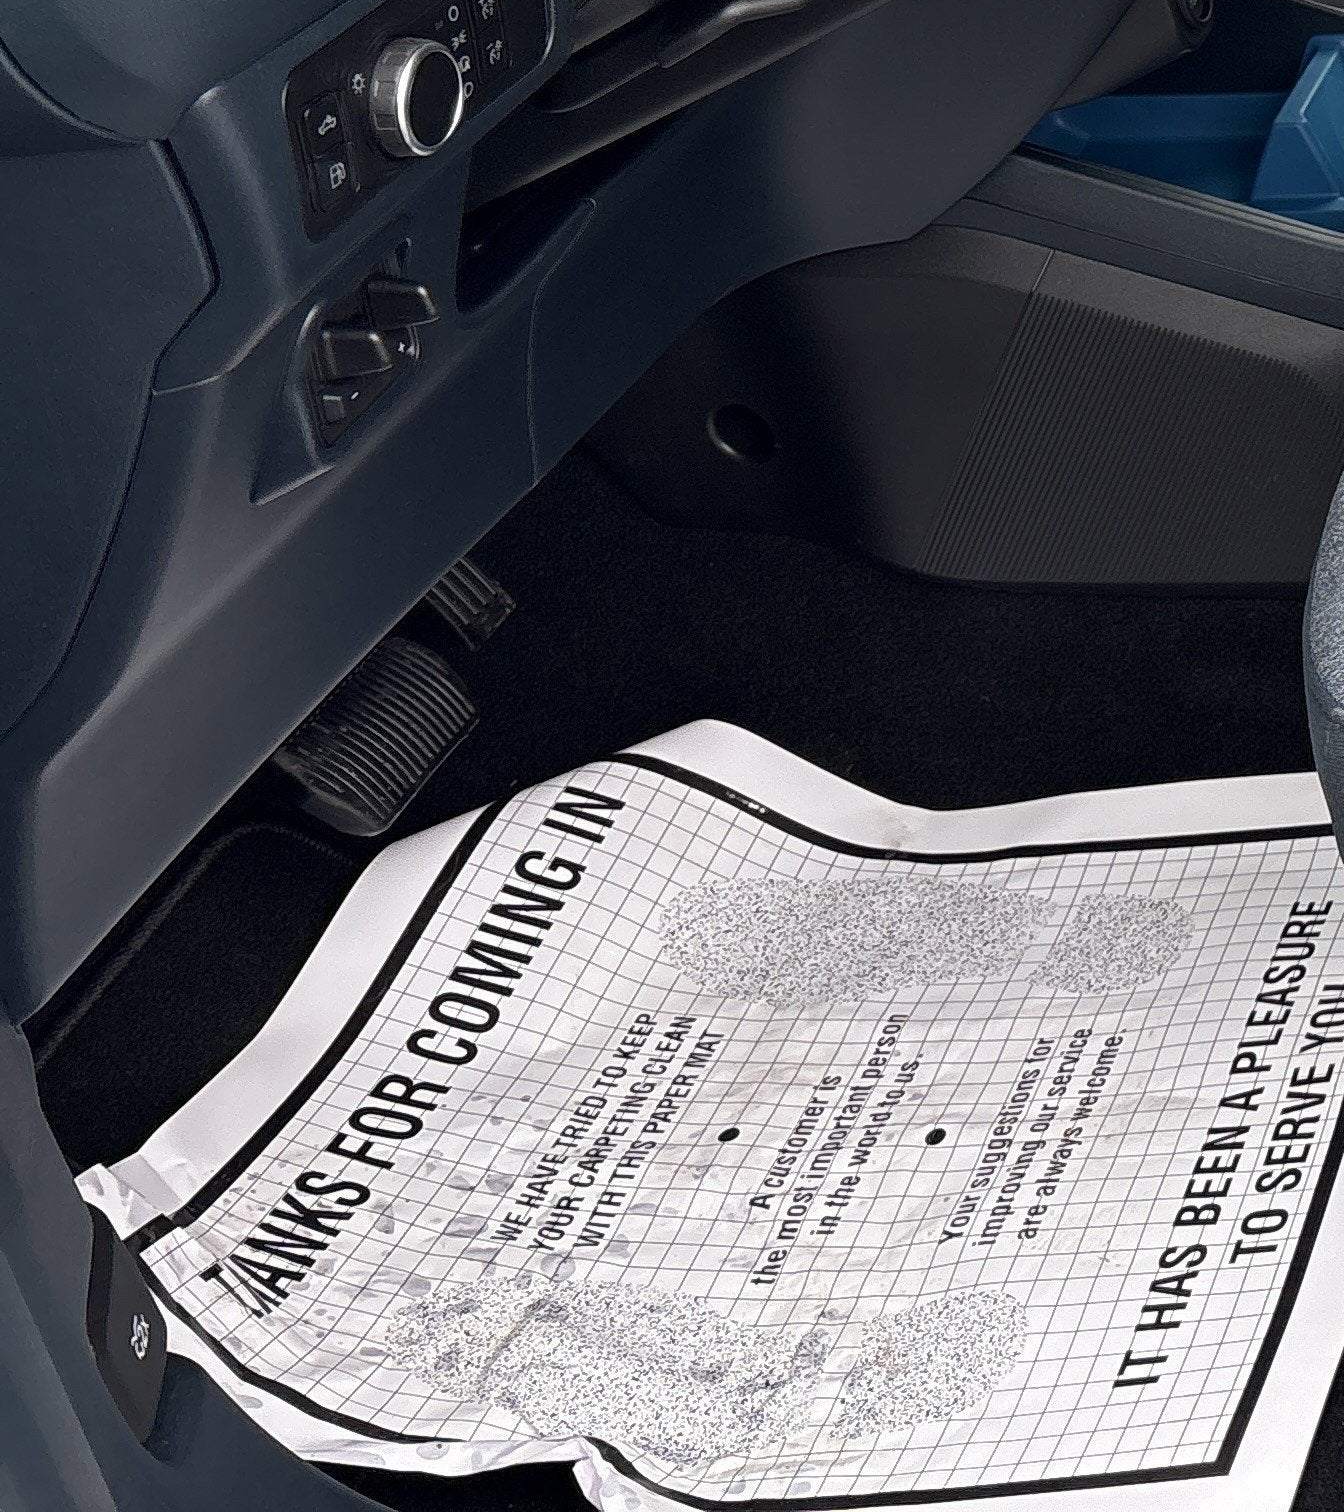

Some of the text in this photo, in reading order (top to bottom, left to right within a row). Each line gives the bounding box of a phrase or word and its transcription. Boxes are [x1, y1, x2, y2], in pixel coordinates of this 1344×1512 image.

[201, 786, 626, 1317] TANKS FOR COMING IN
[490, 1013, 657, 1242] WE HAVE TRIED TO KEEP
[527, 1016, 697, 1251] YOUR CARPETING CLEAN
[573, 1029, 724, 1248] WITH THIS PAPER MAT
[749, 1074, 842, 1210] A customer is
[751, 1014, 909, 1285] the most important person
[809, 1053, 924, 1235] in the world to us.
[938, 1038, 1055, 1245] Your suggestions for
[971, 1028, 1093, 1247] improving our service
[1017, 1028, 1127, 1240] are always welcome.
[1113, 899, 1334, 1389] IT HAS BEEN A PLEASURE
[1254, 1061, 1336, 1192] SERVE
[1229, 1207, 1289, 1265] TO
